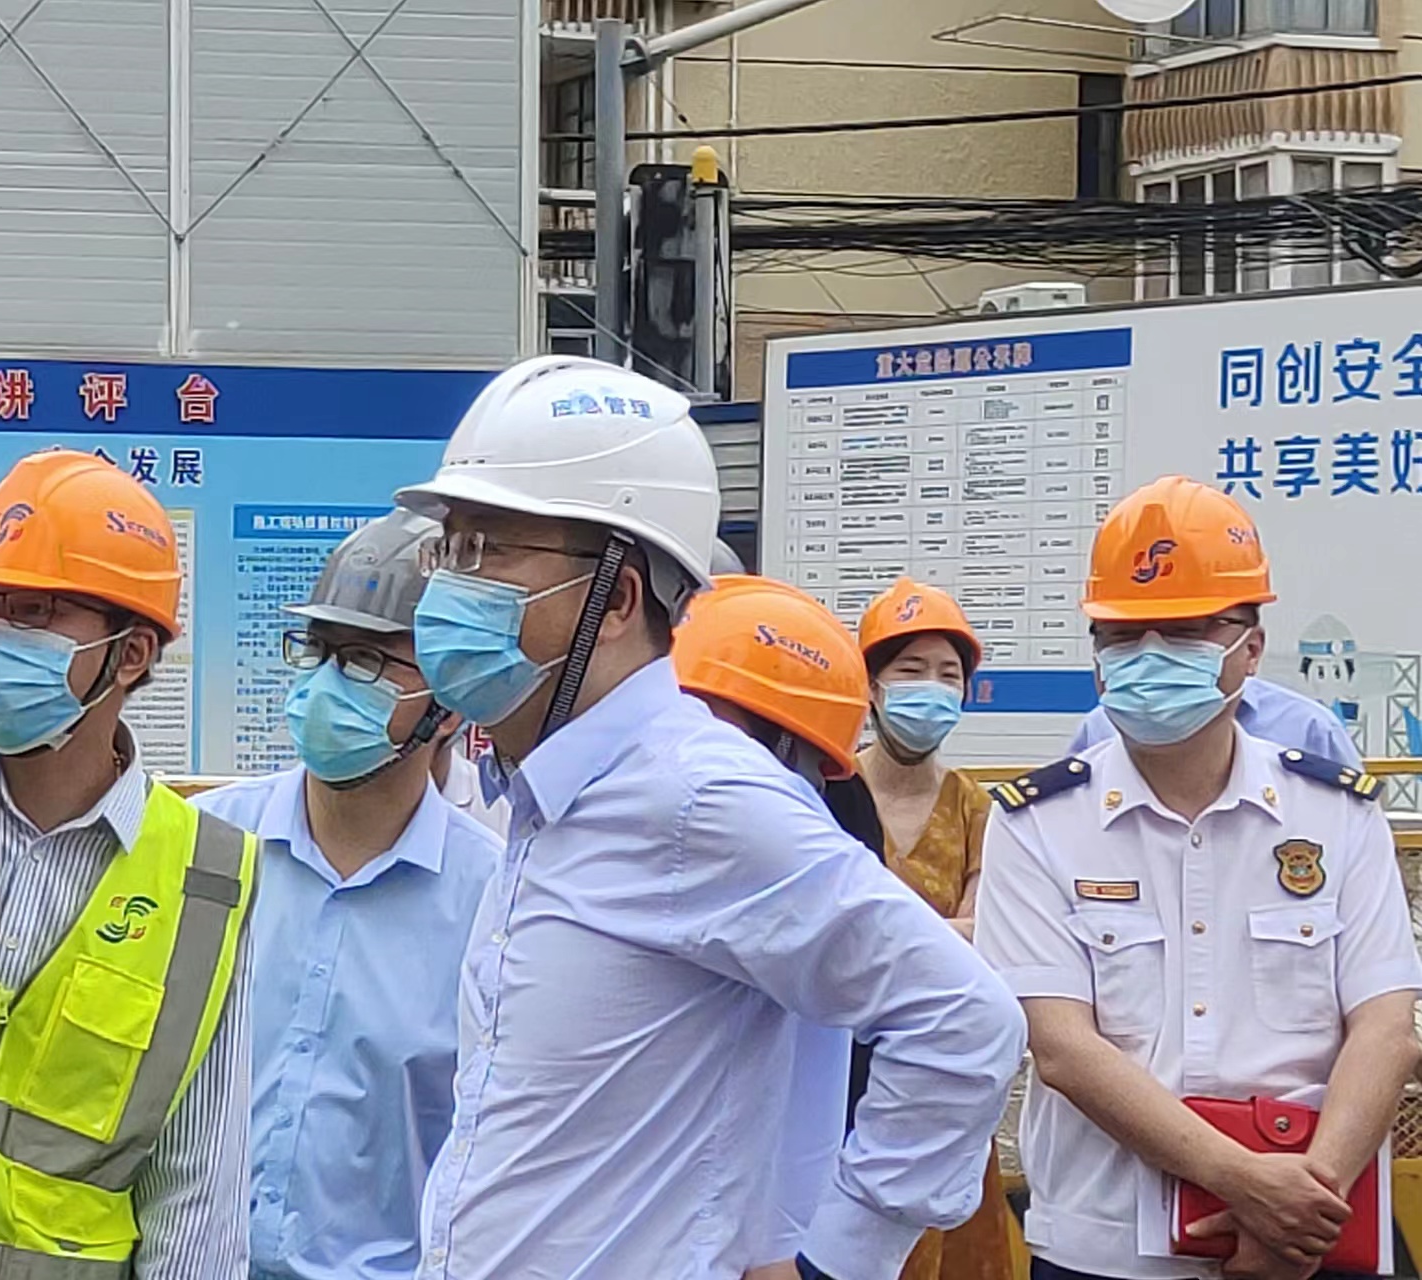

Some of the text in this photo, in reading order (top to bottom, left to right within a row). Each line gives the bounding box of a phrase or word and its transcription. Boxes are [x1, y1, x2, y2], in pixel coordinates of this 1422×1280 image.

[1220, 333, 1422, 408] 同创安全
[1216, 430, 1422, 498] 共享美好
